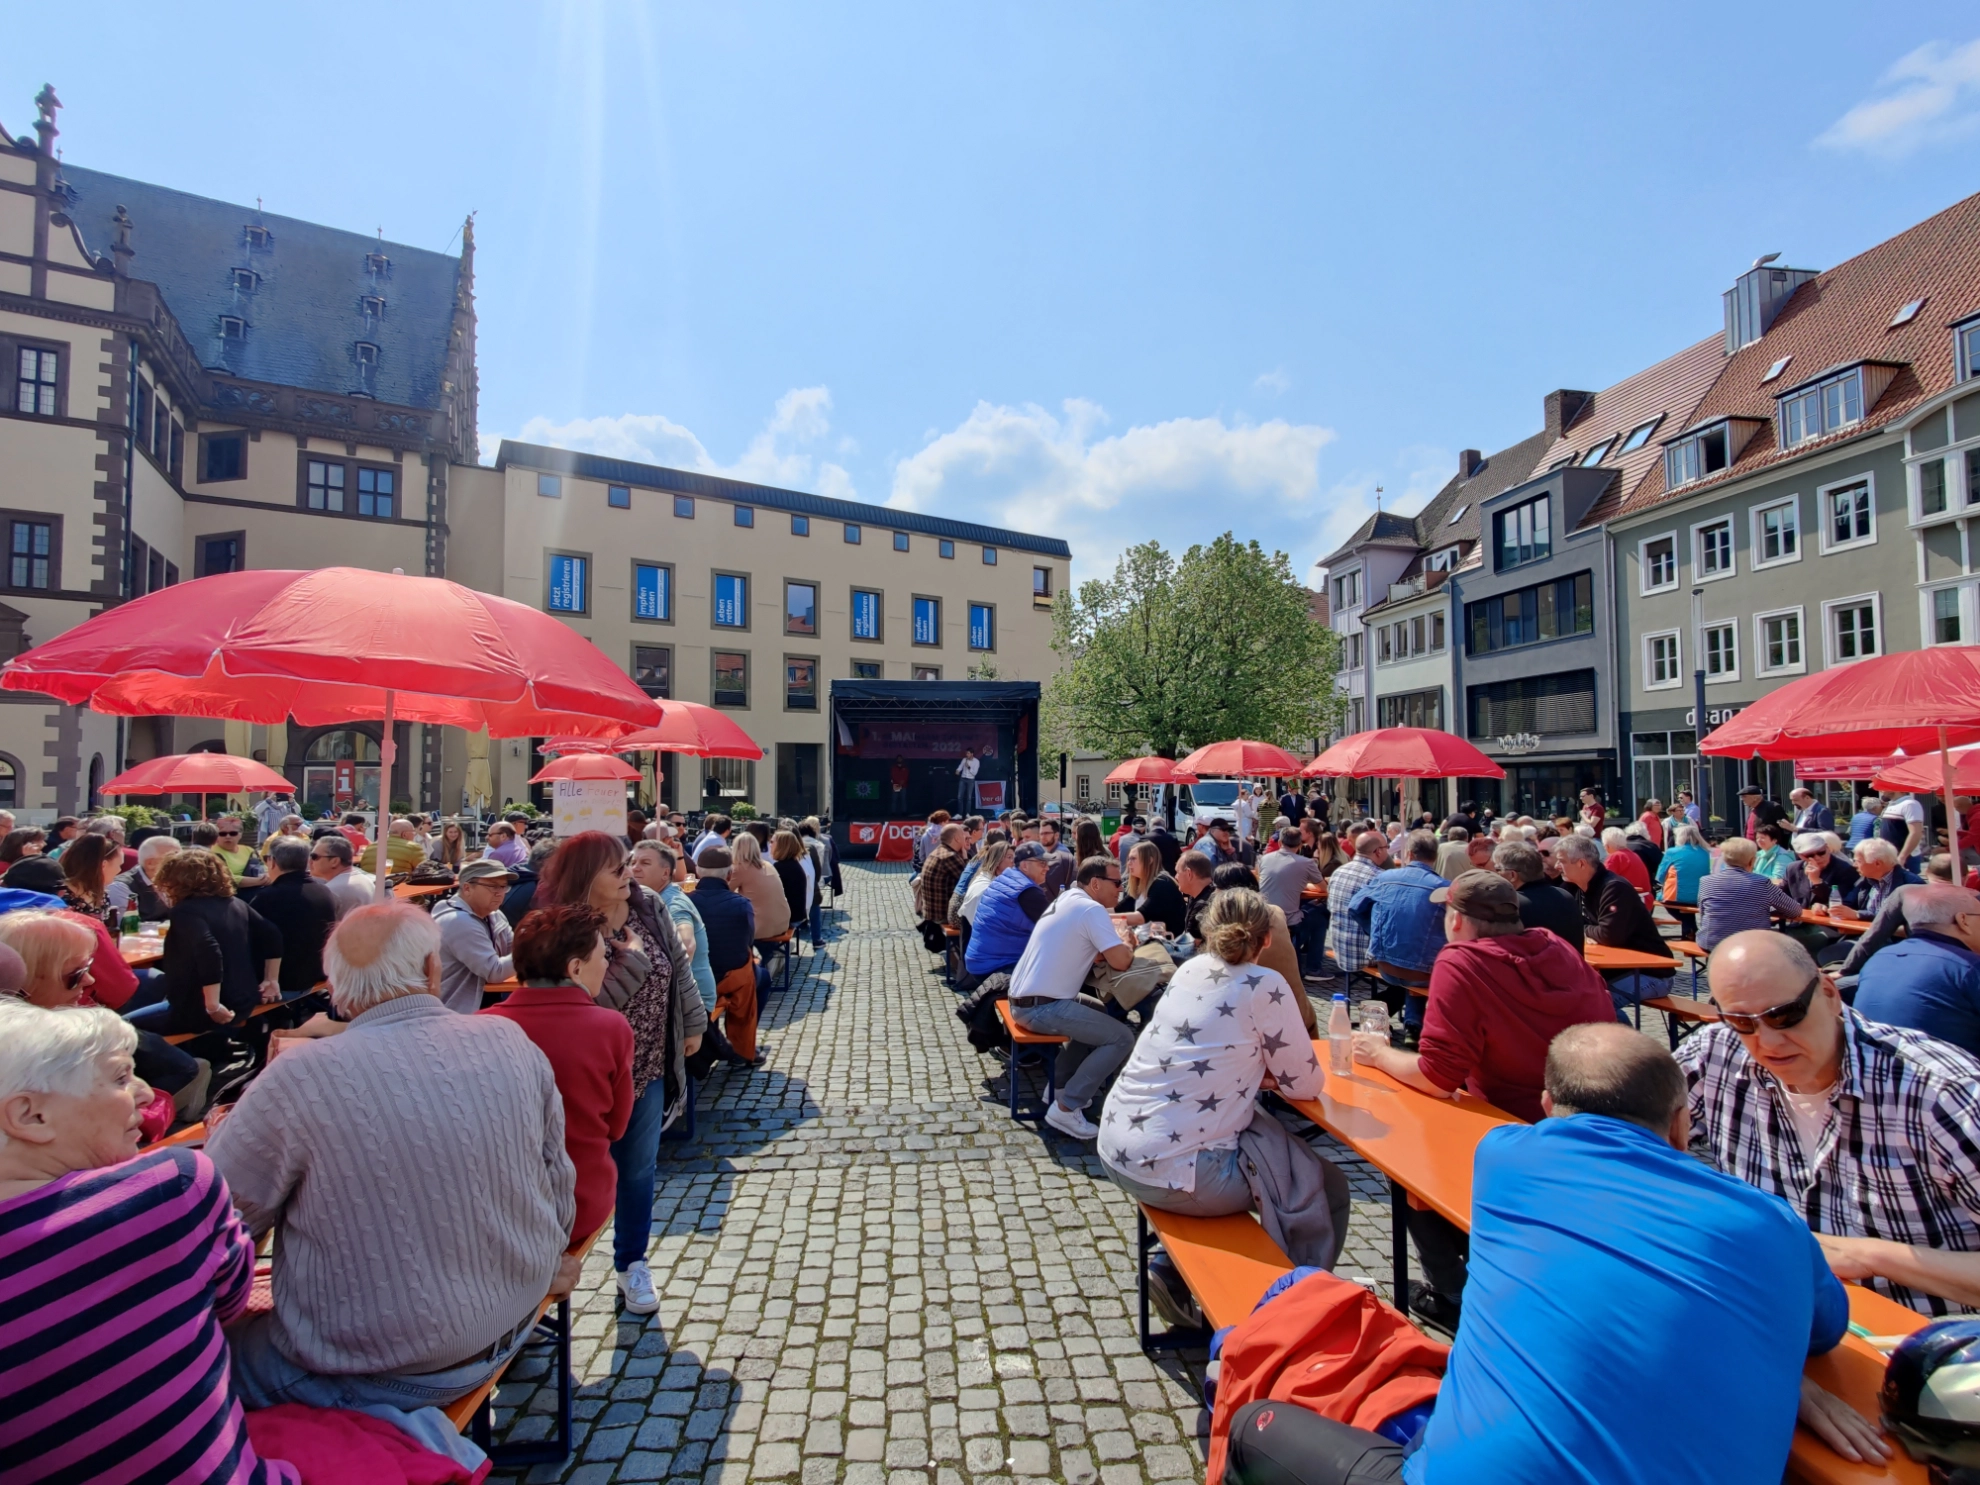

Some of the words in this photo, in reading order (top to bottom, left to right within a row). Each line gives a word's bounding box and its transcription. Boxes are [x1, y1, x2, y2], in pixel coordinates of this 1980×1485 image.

[563, 560, 571, 608] registrieren
[552, 586, 561, 607] Jetzt
[638, 586, 648, 615] Impfen
[647, 591, 655, 616] lassen
[1685, 708, 1734, 726] dan
[932, 741, 962, 752] 2022
[559, 781, 583, 797] Alle
[587, 783, 620, 797] Feuer
